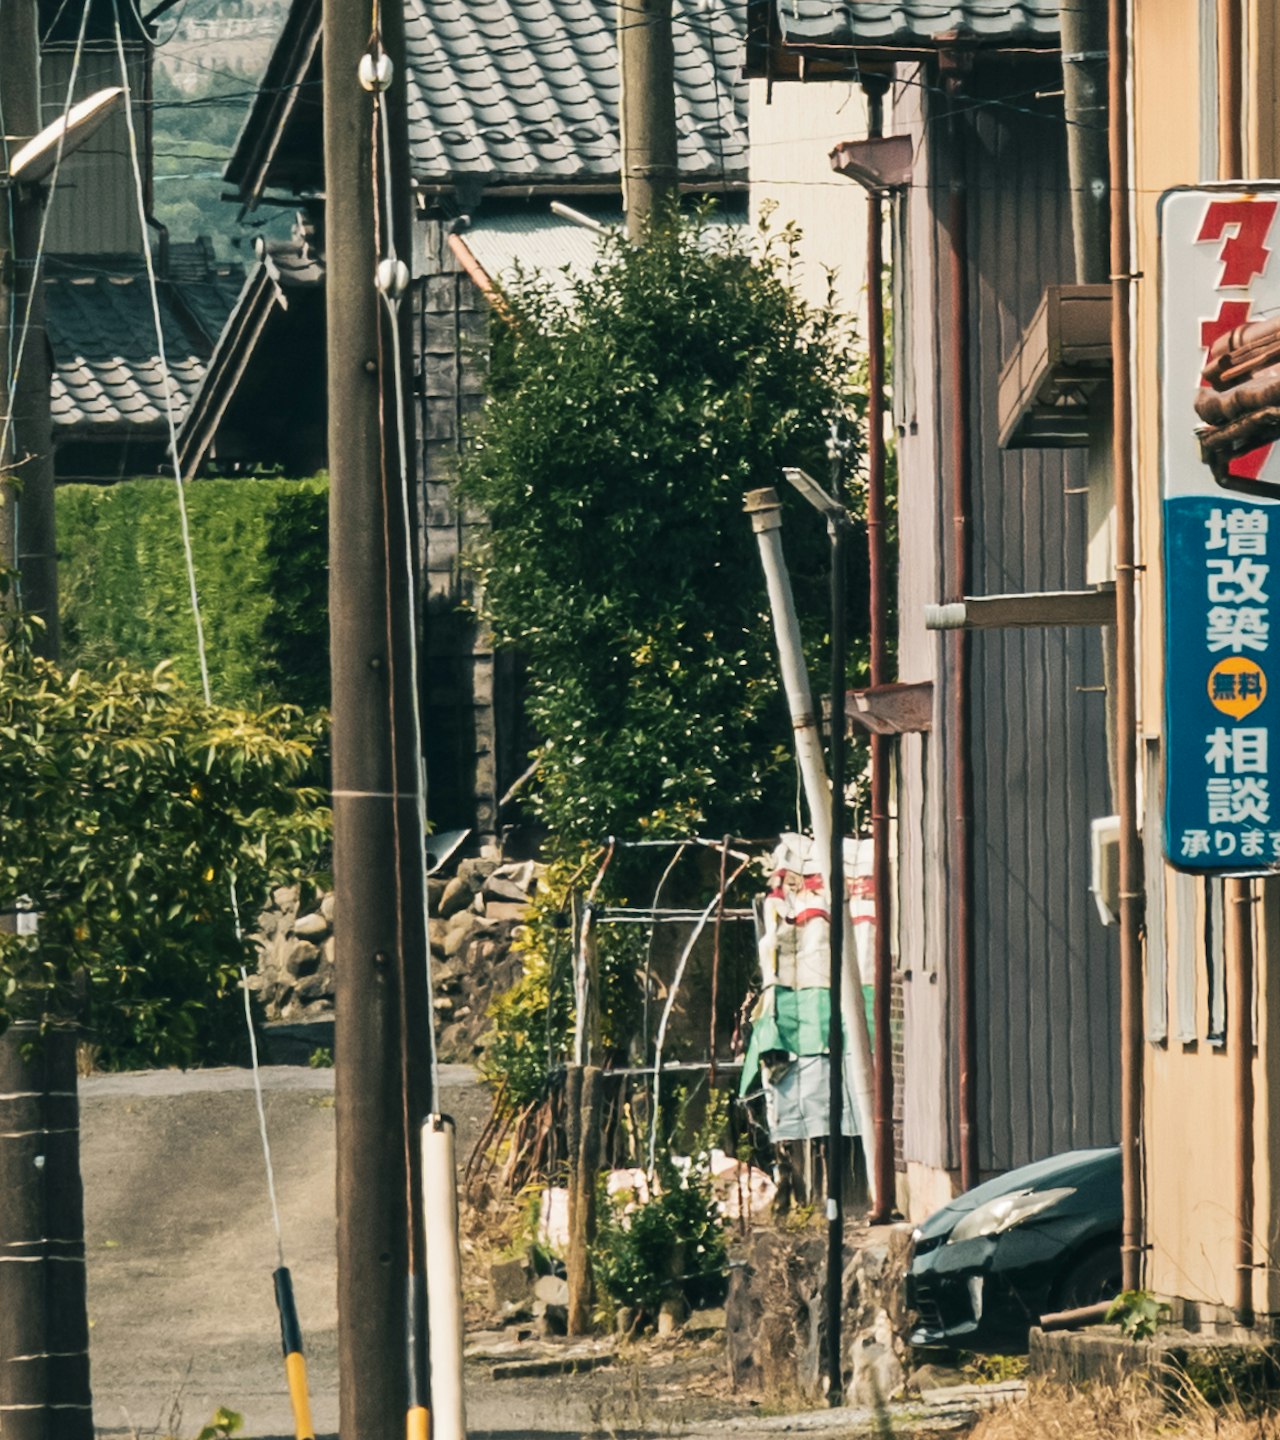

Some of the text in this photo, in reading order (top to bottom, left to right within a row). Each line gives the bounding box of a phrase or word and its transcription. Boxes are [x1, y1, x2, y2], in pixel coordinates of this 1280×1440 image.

[1205, 508, 1270, 653] 増改築
[1212, 671, 1263, 701] 無料
[1205, 727, 1271, 825] 相談
